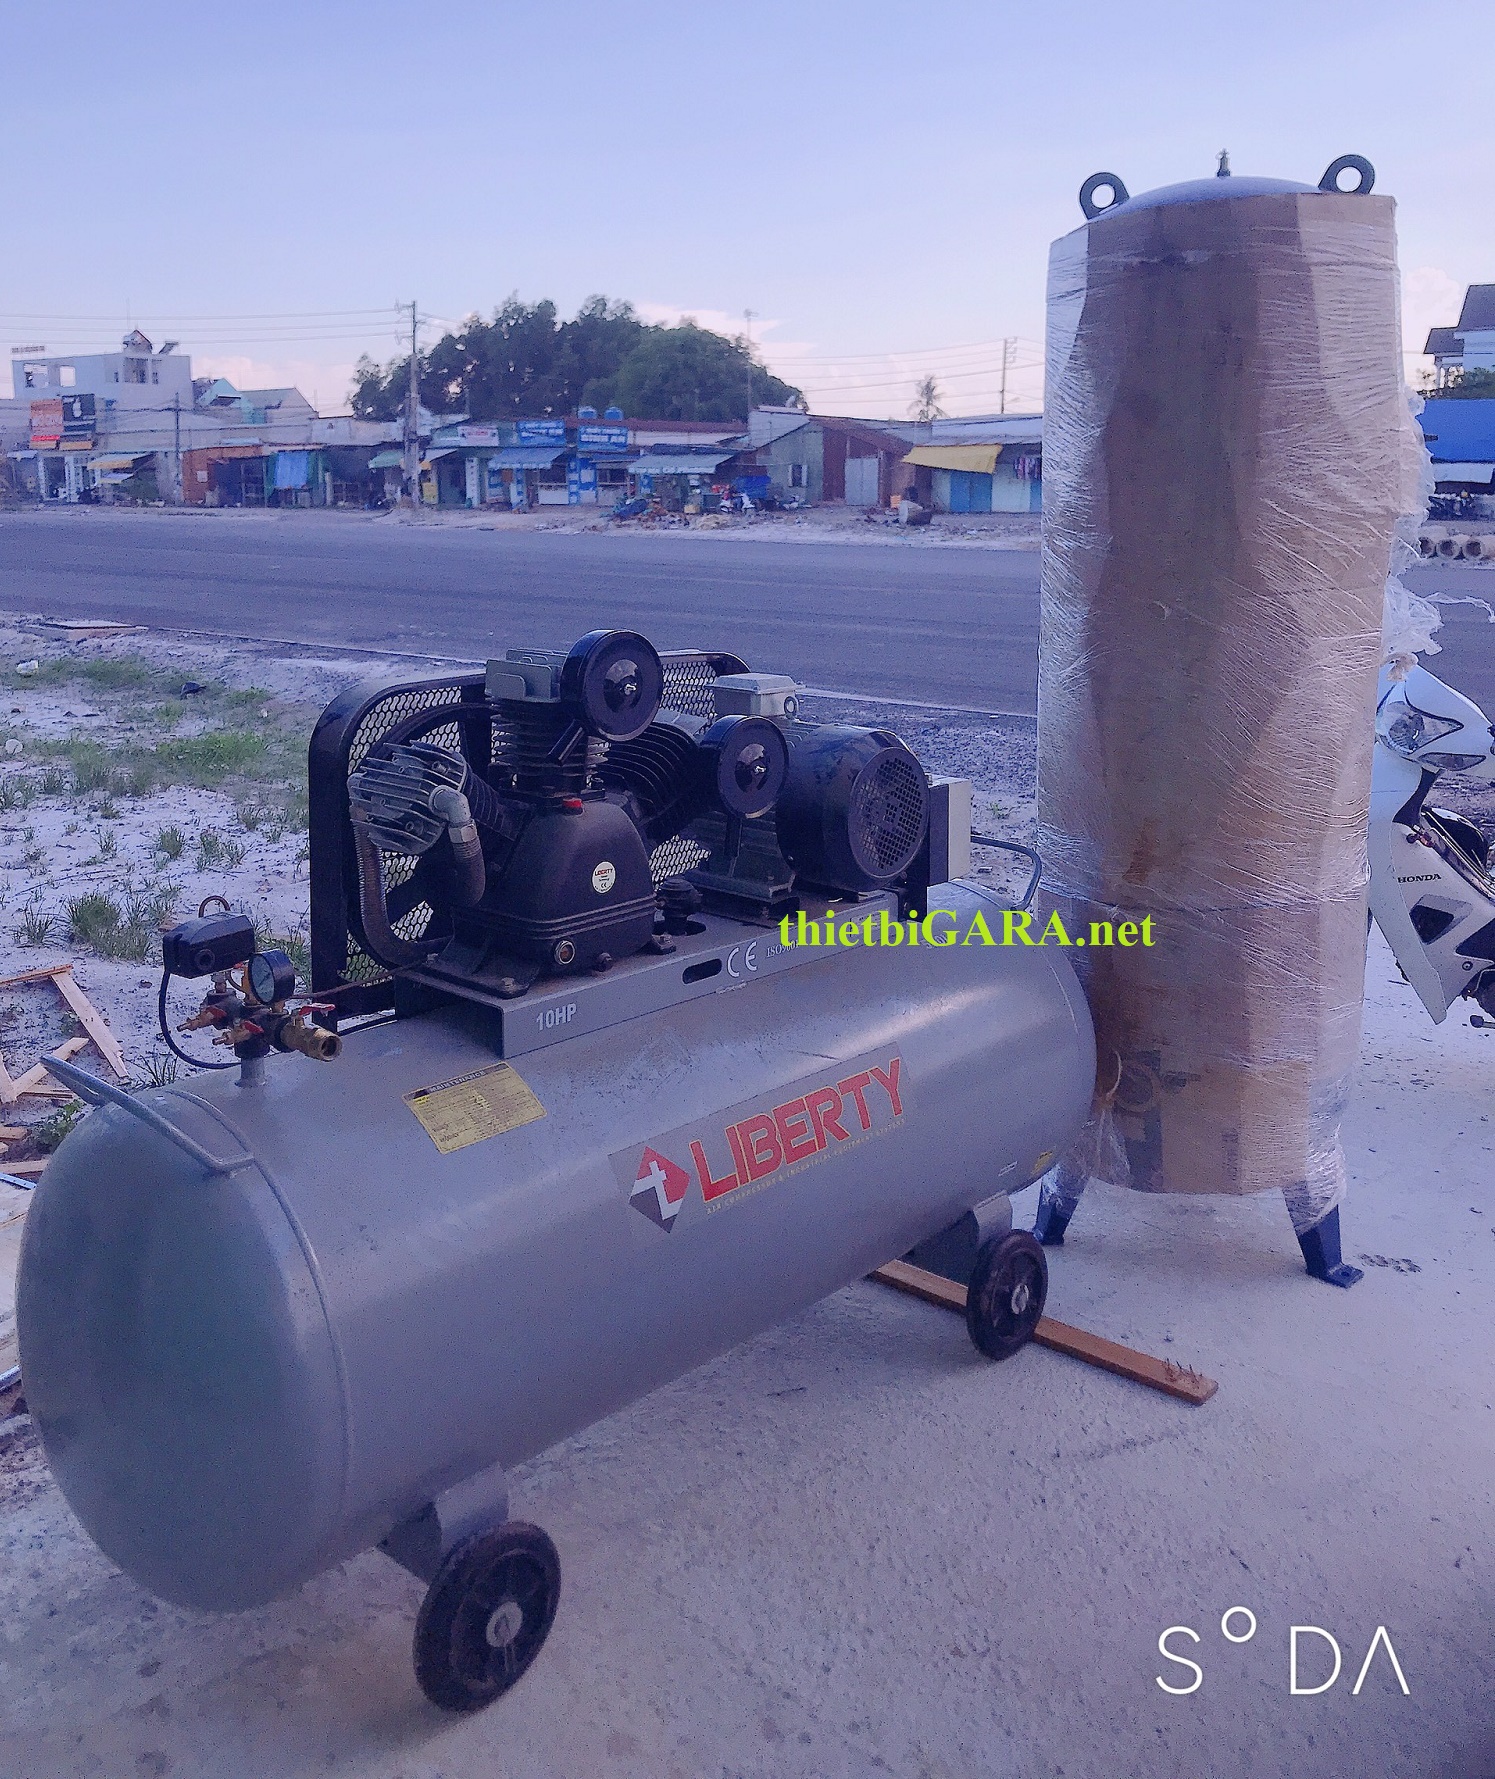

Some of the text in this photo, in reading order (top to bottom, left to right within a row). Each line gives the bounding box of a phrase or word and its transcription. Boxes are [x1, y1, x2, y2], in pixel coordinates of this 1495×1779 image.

[1397, 873, 1442, 884] HONDA
[727, 941, 758, 978] CE
[536, 1003, 577, 1031] 10HP
[689, 1058, 903, 1203] LIBERTY
